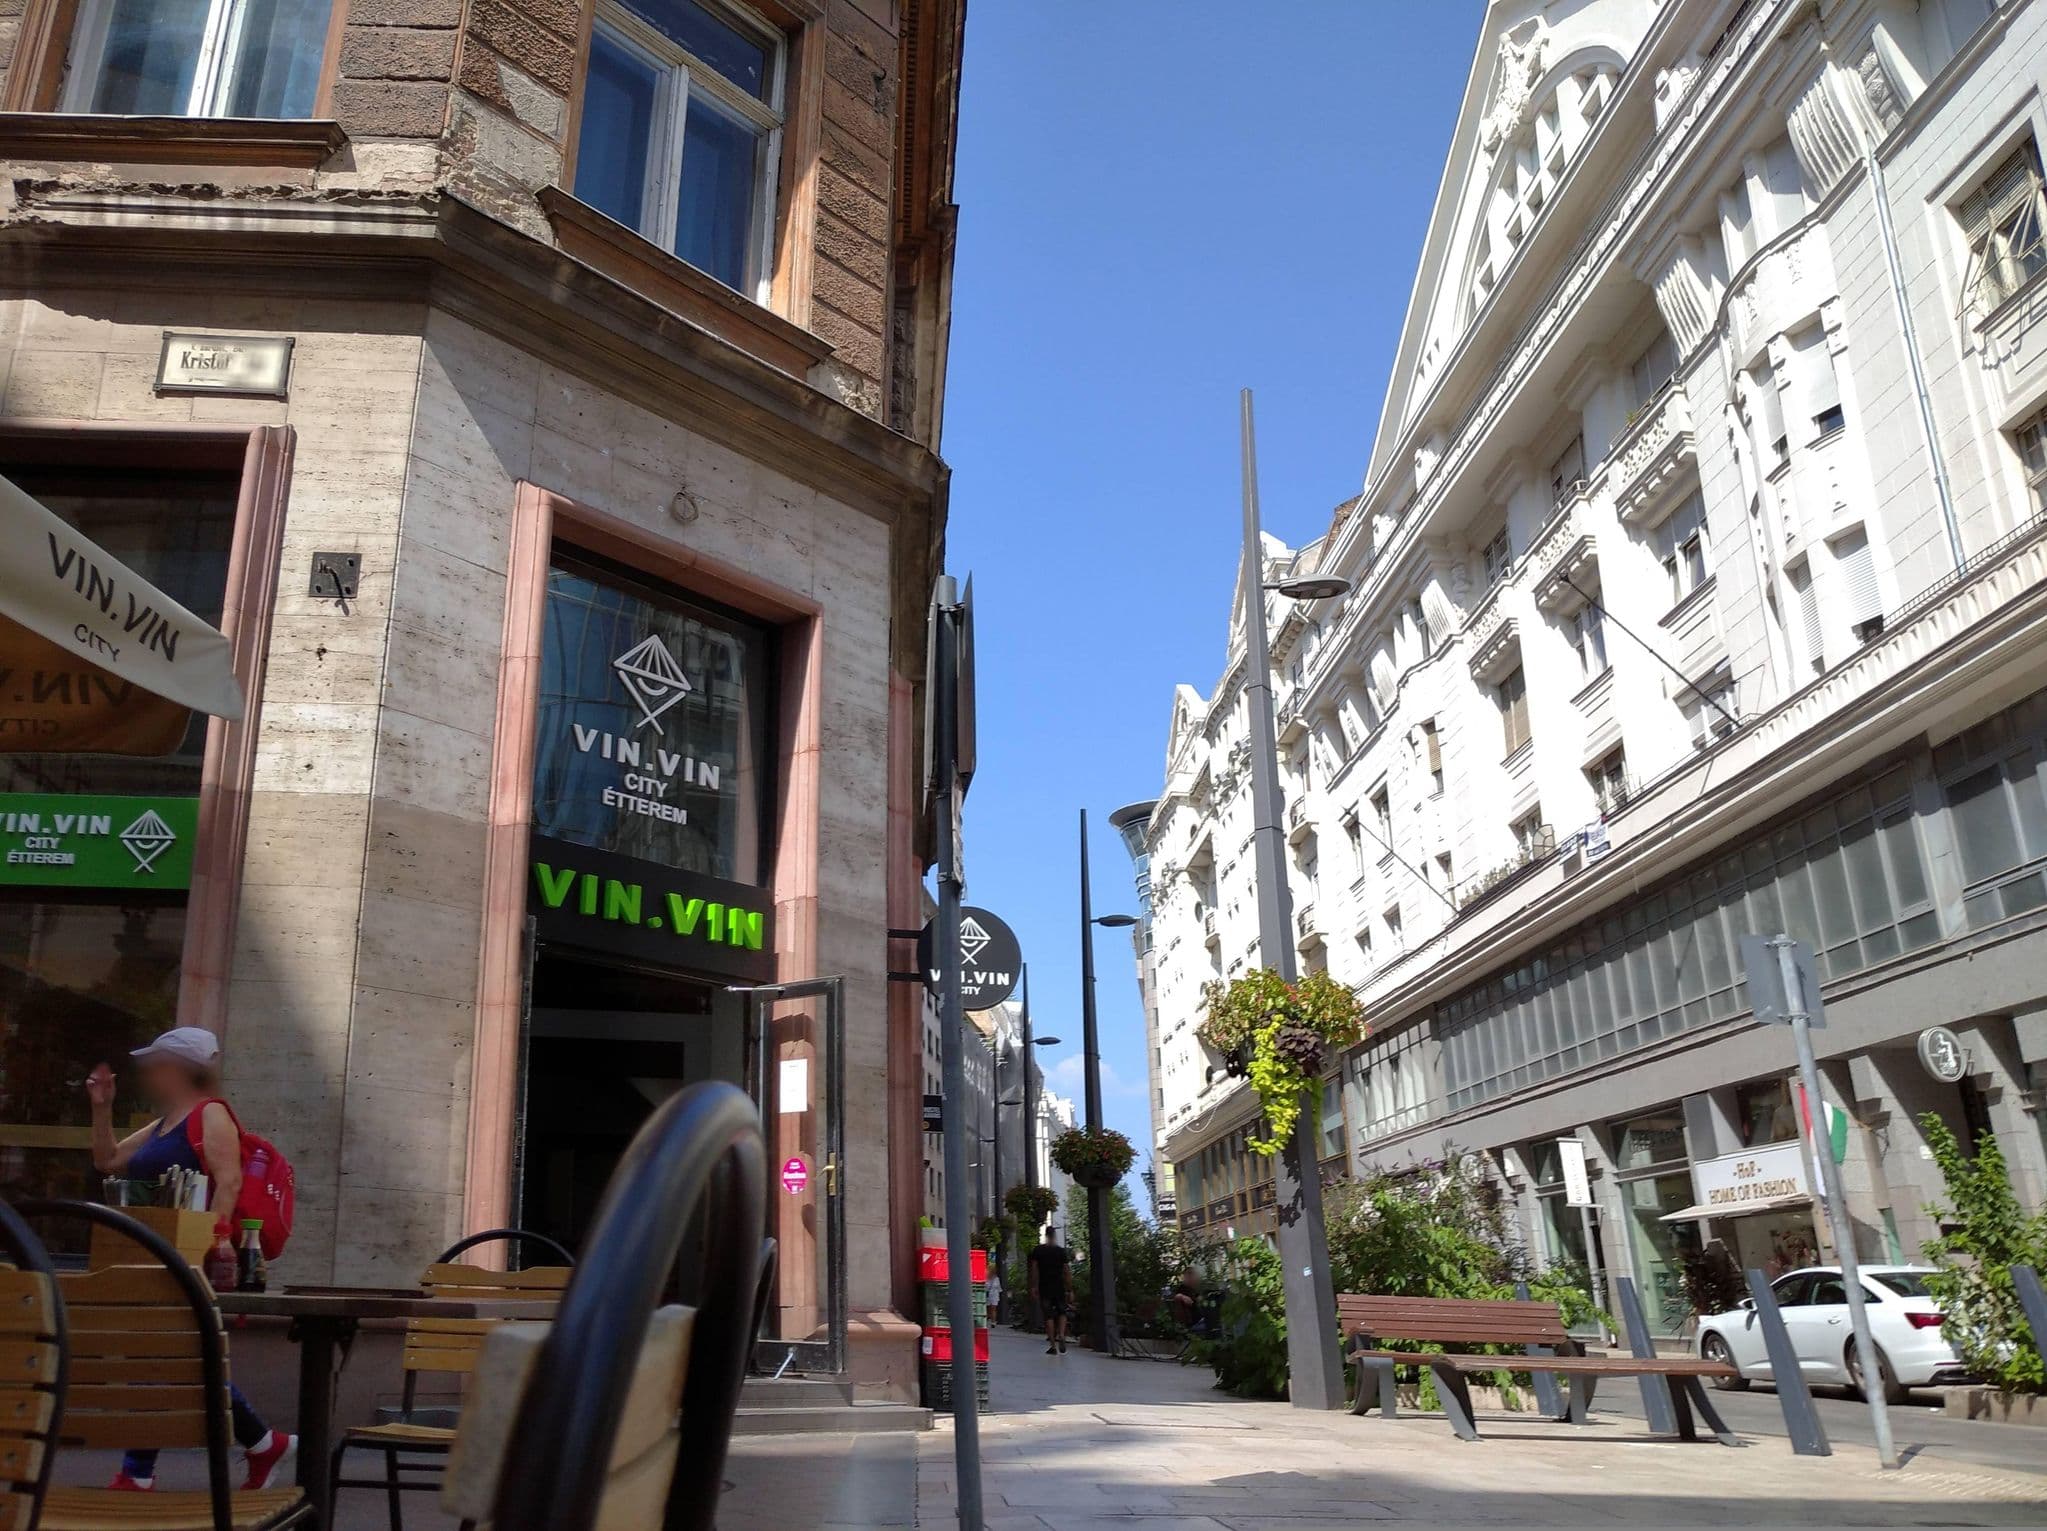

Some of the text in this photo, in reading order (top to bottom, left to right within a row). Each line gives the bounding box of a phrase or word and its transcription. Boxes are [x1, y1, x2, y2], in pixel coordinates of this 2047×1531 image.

[48, 531, 180, 662] VIN.VIN
[74, 623, 120, 662] CITY
[573, 723, 720, 790] VIN.VIN
[624, 772, 668, 798] CITY
[602, 786, 687, 825] ÉTTEREM
[0, 812, 112, 835] IN.VIN
[6, 848, 75, 864] ÉTTEREM
[24, 836, 61, 849] CITY
[535, 862, 764, 950] VIN.VIN
[929, 968, 1010, 986] V.VIN
[1709, 1178, 1798, 1205] HOME OF FASHION
